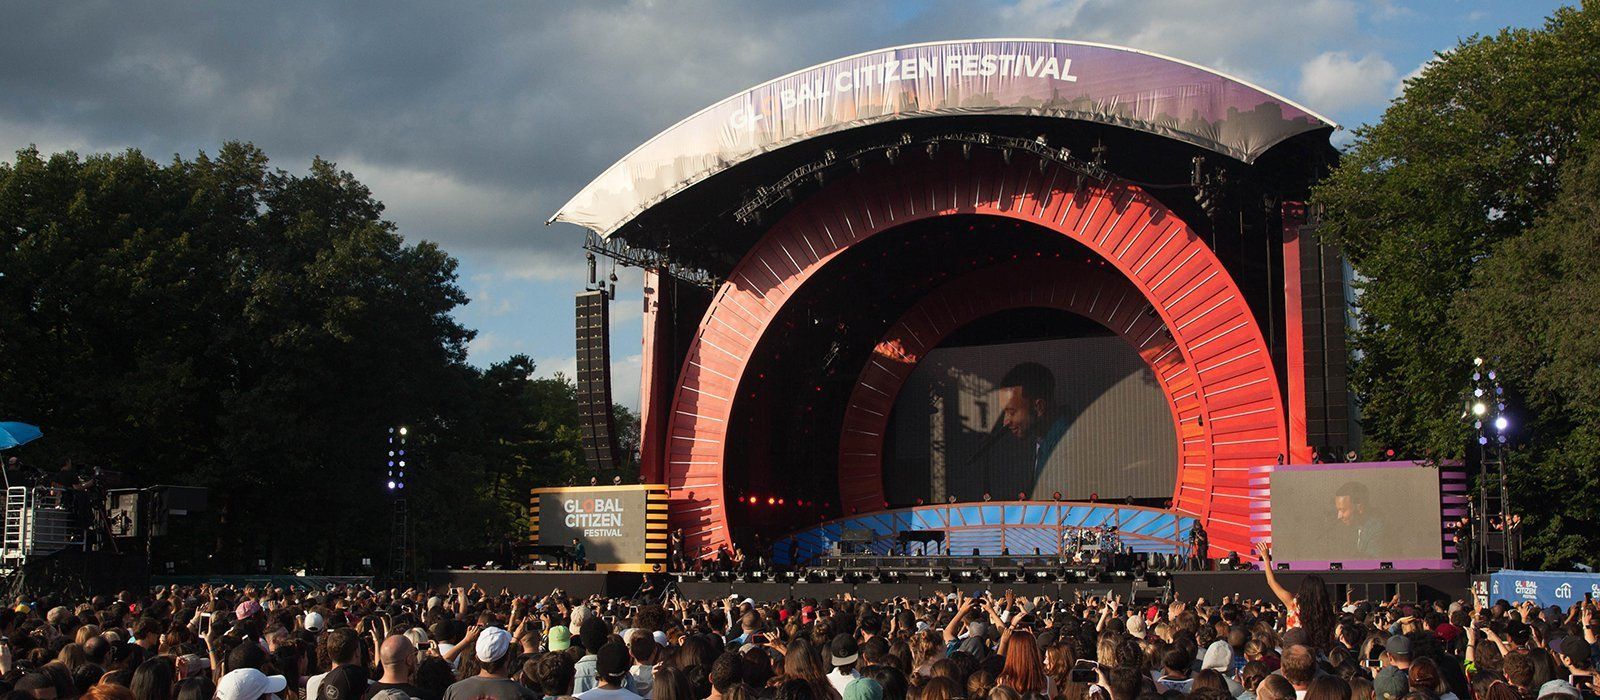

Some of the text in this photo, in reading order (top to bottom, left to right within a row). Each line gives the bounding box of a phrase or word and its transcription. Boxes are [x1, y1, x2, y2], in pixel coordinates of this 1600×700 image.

[729, 54, 1078, 132] GLOBAL CITIZEN FESTIVAL
[564, 498, 624, 513] GLOBAL
[565, 513, 622, 528] CITIZEN
[584, 528, 623, 537] FESTIVAL
[1515, 580, 1538, 588] GLOBAL
[1515, 587, 1537, 595] CITIZEN
[1555, 583, 1572, 599] citi
